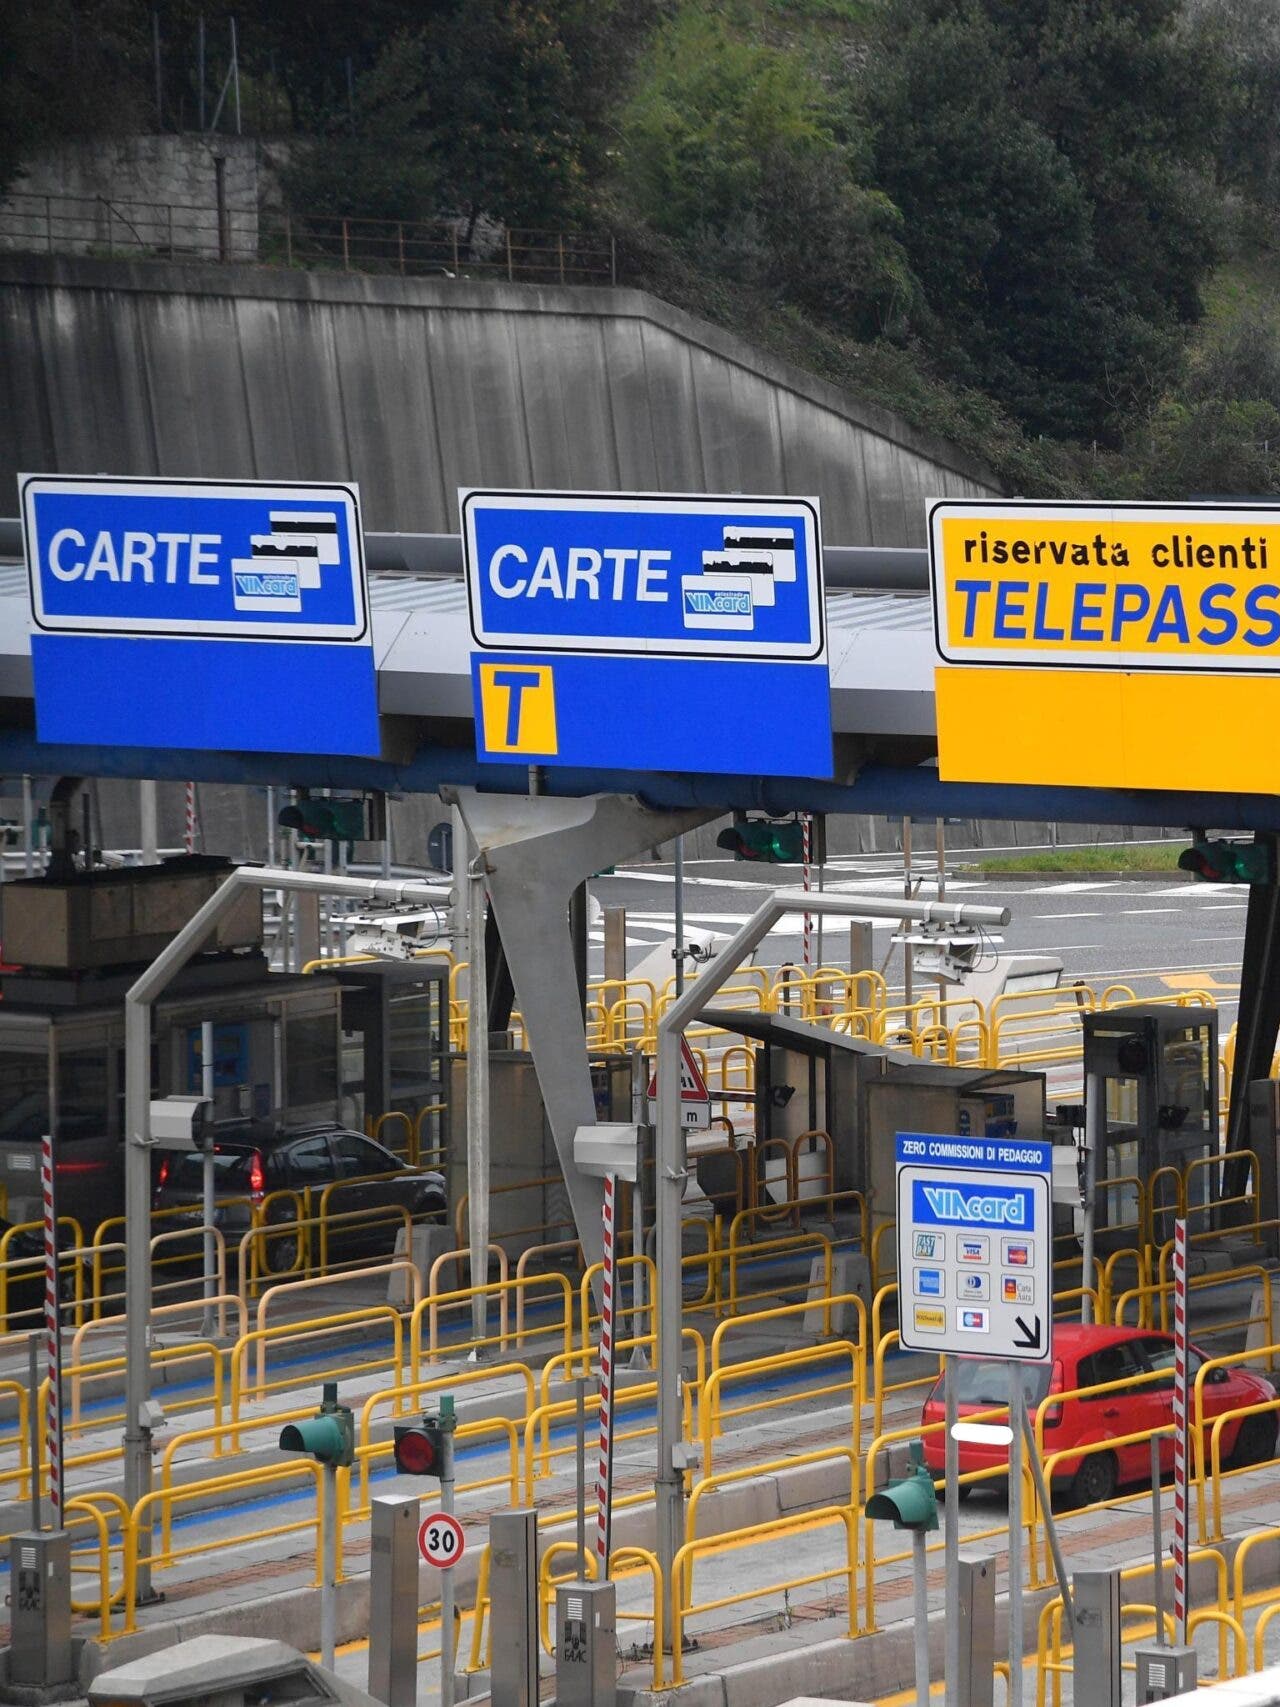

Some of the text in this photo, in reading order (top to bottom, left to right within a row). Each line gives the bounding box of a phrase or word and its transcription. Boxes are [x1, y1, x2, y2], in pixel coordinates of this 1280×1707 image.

[48, 528, 222, 585] CARTE
[963, 531, 1268, 570] riservata clienti
[235, 575, 298, 596] VIAcard
[488, 544, 672, 603] CARTE
[685, 592, 751, 613] VIAcard
[494, 670, 541, 747] T
[687, 1111, 698, 1122] m
[903, 1140, 1043, 1164] ZERO COMMISSIONI DI PEDAGGIO
[922, 1186, 1025, 1224] VIAcard
[429, 1528, 454, 1553] 30
